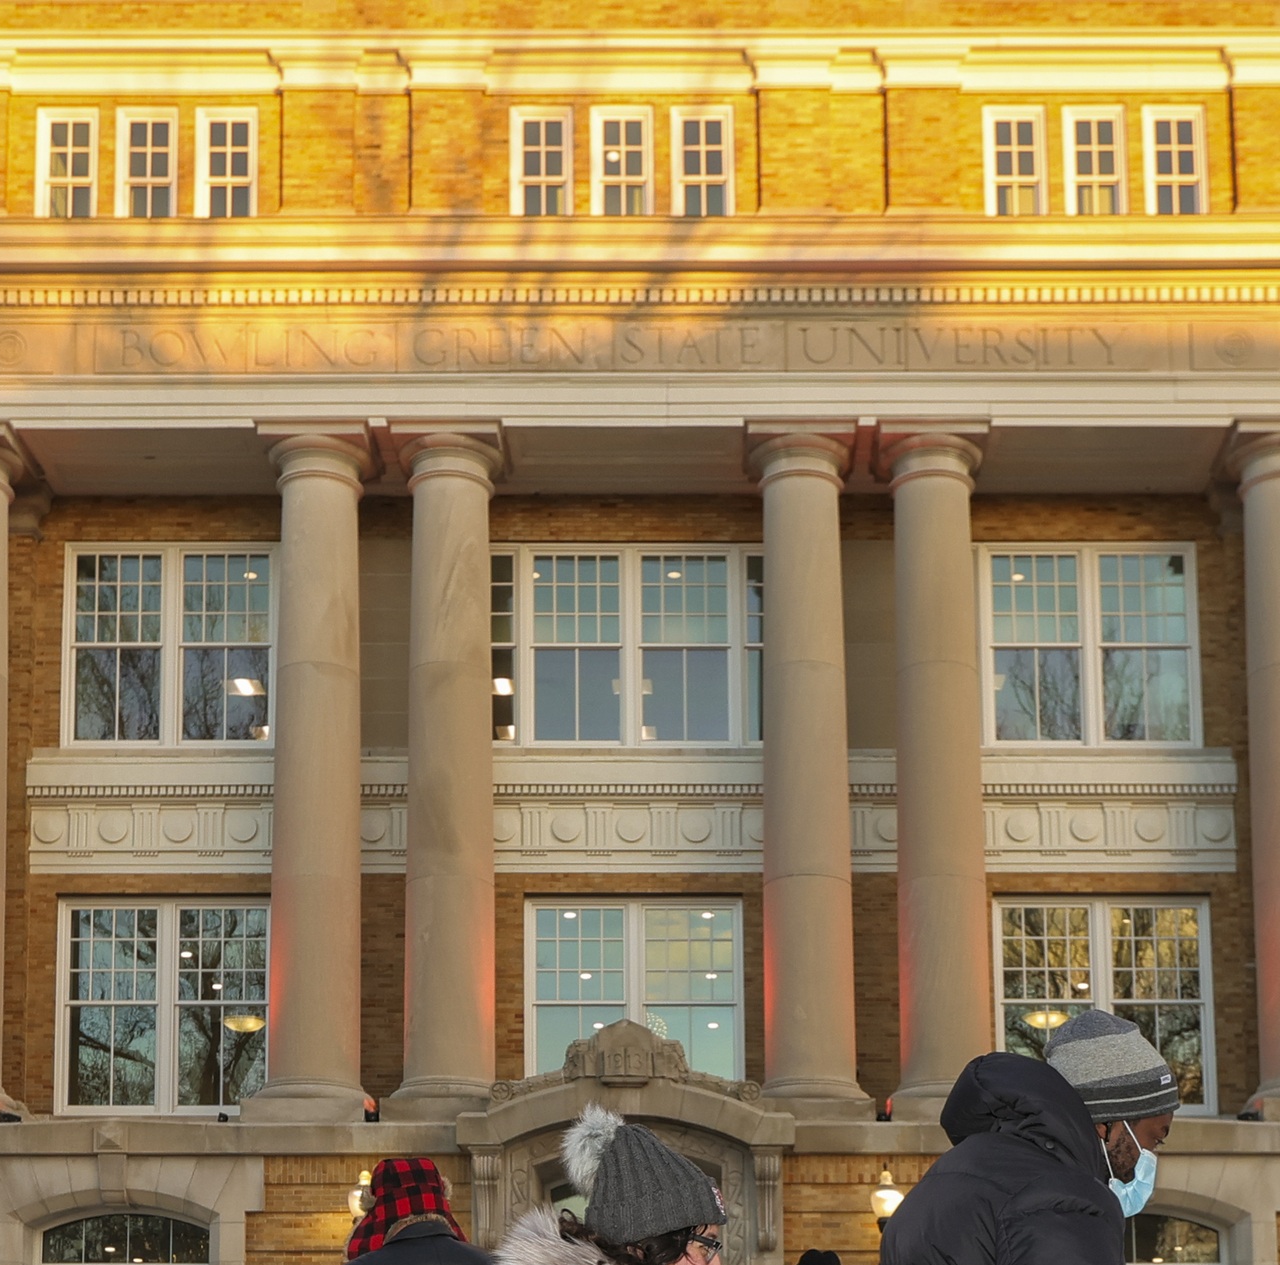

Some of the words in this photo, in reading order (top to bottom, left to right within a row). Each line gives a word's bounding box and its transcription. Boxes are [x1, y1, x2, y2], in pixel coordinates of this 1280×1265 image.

[120, 328, 379, 367] BOWLING
[413, 327, 586, 366] GREEN
[620, 326, 761, 366] STATE
[798, 326, 1118, 367] UNIVERSITY
[606, 1052, 642, 1071] 1913
